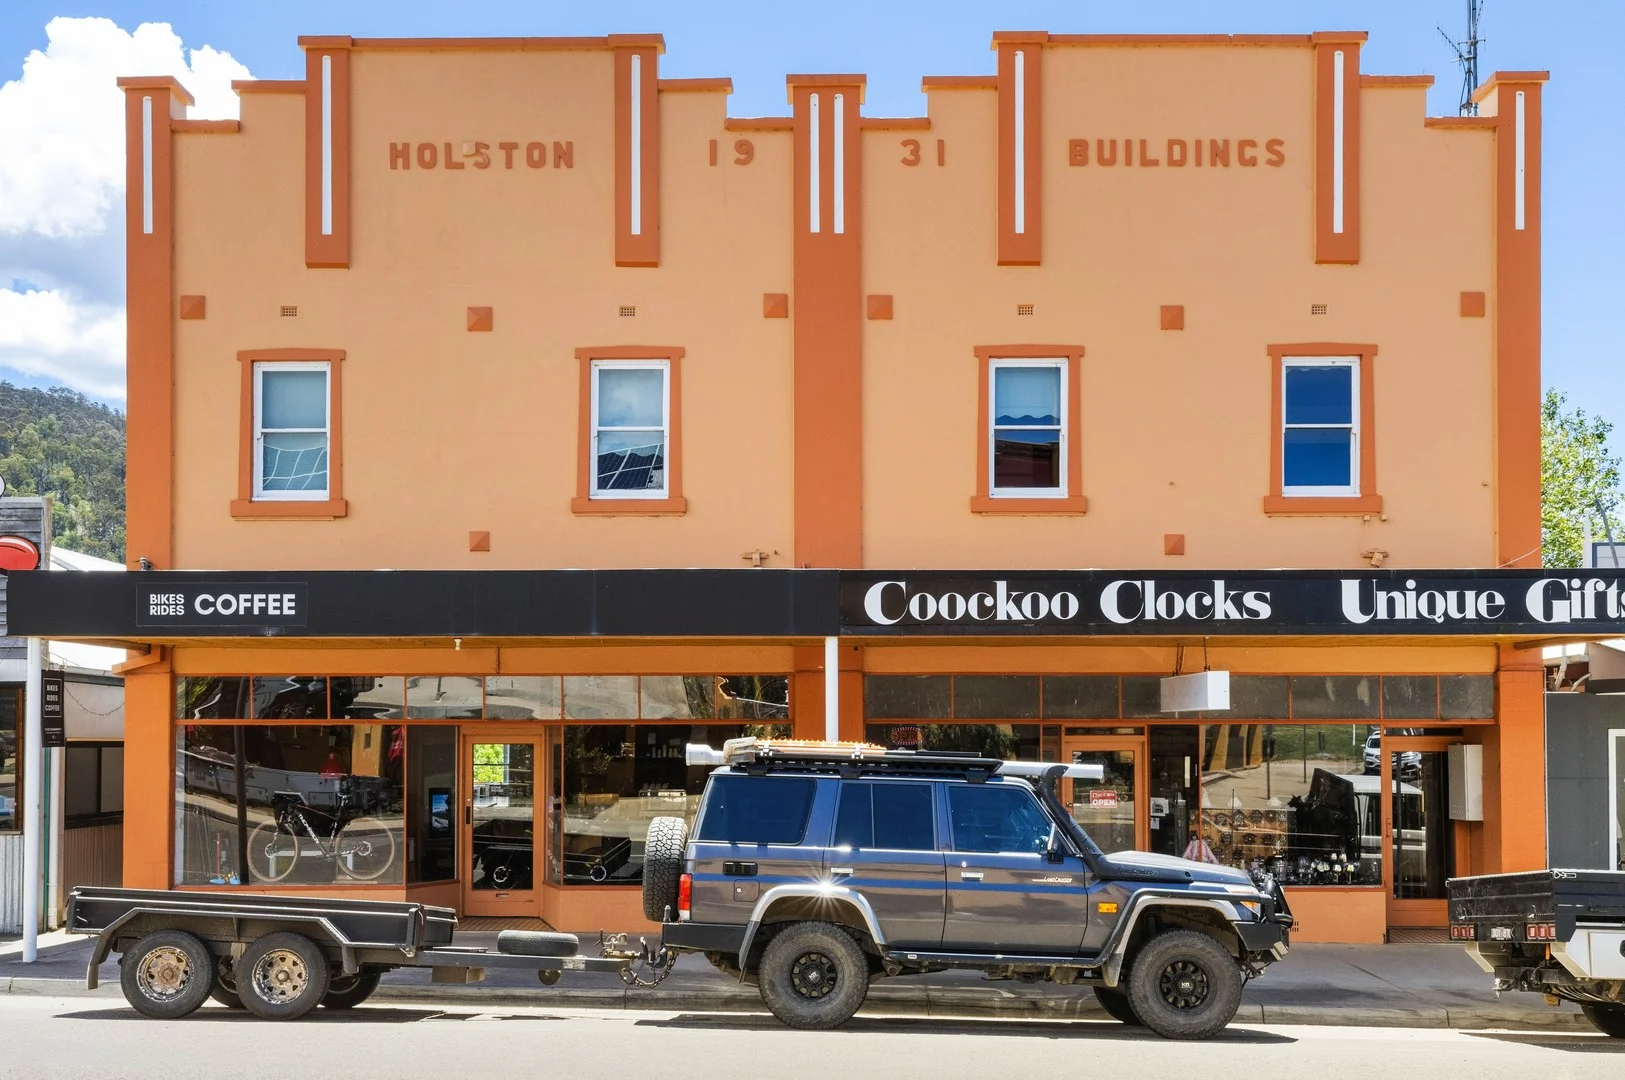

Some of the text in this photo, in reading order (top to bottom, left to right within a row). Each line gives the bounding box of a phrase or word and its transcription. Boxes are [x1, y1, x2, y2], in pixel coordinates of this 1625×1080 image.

[390, 141, 575, 171] HOLSTON
[710, 139, 755, 167] 19
[900, 139, 947, 167] 31
[1069, 139, 1287, 168] BUILDINGS
[149, 593, 185, 605] BIKES
[194, 593, 296, 615] COFFEE
[864, 578, 1625, 625] Coockoo Clocks Unique Gift
[149, 604, 185, 616] RIDES
[46, 684, 59, 692] BIKES
[46, 694, 59, 702] RIDES
[44, 704, 61, 712] COFFEE
[1092, 799, 1116, 807] OPEN
